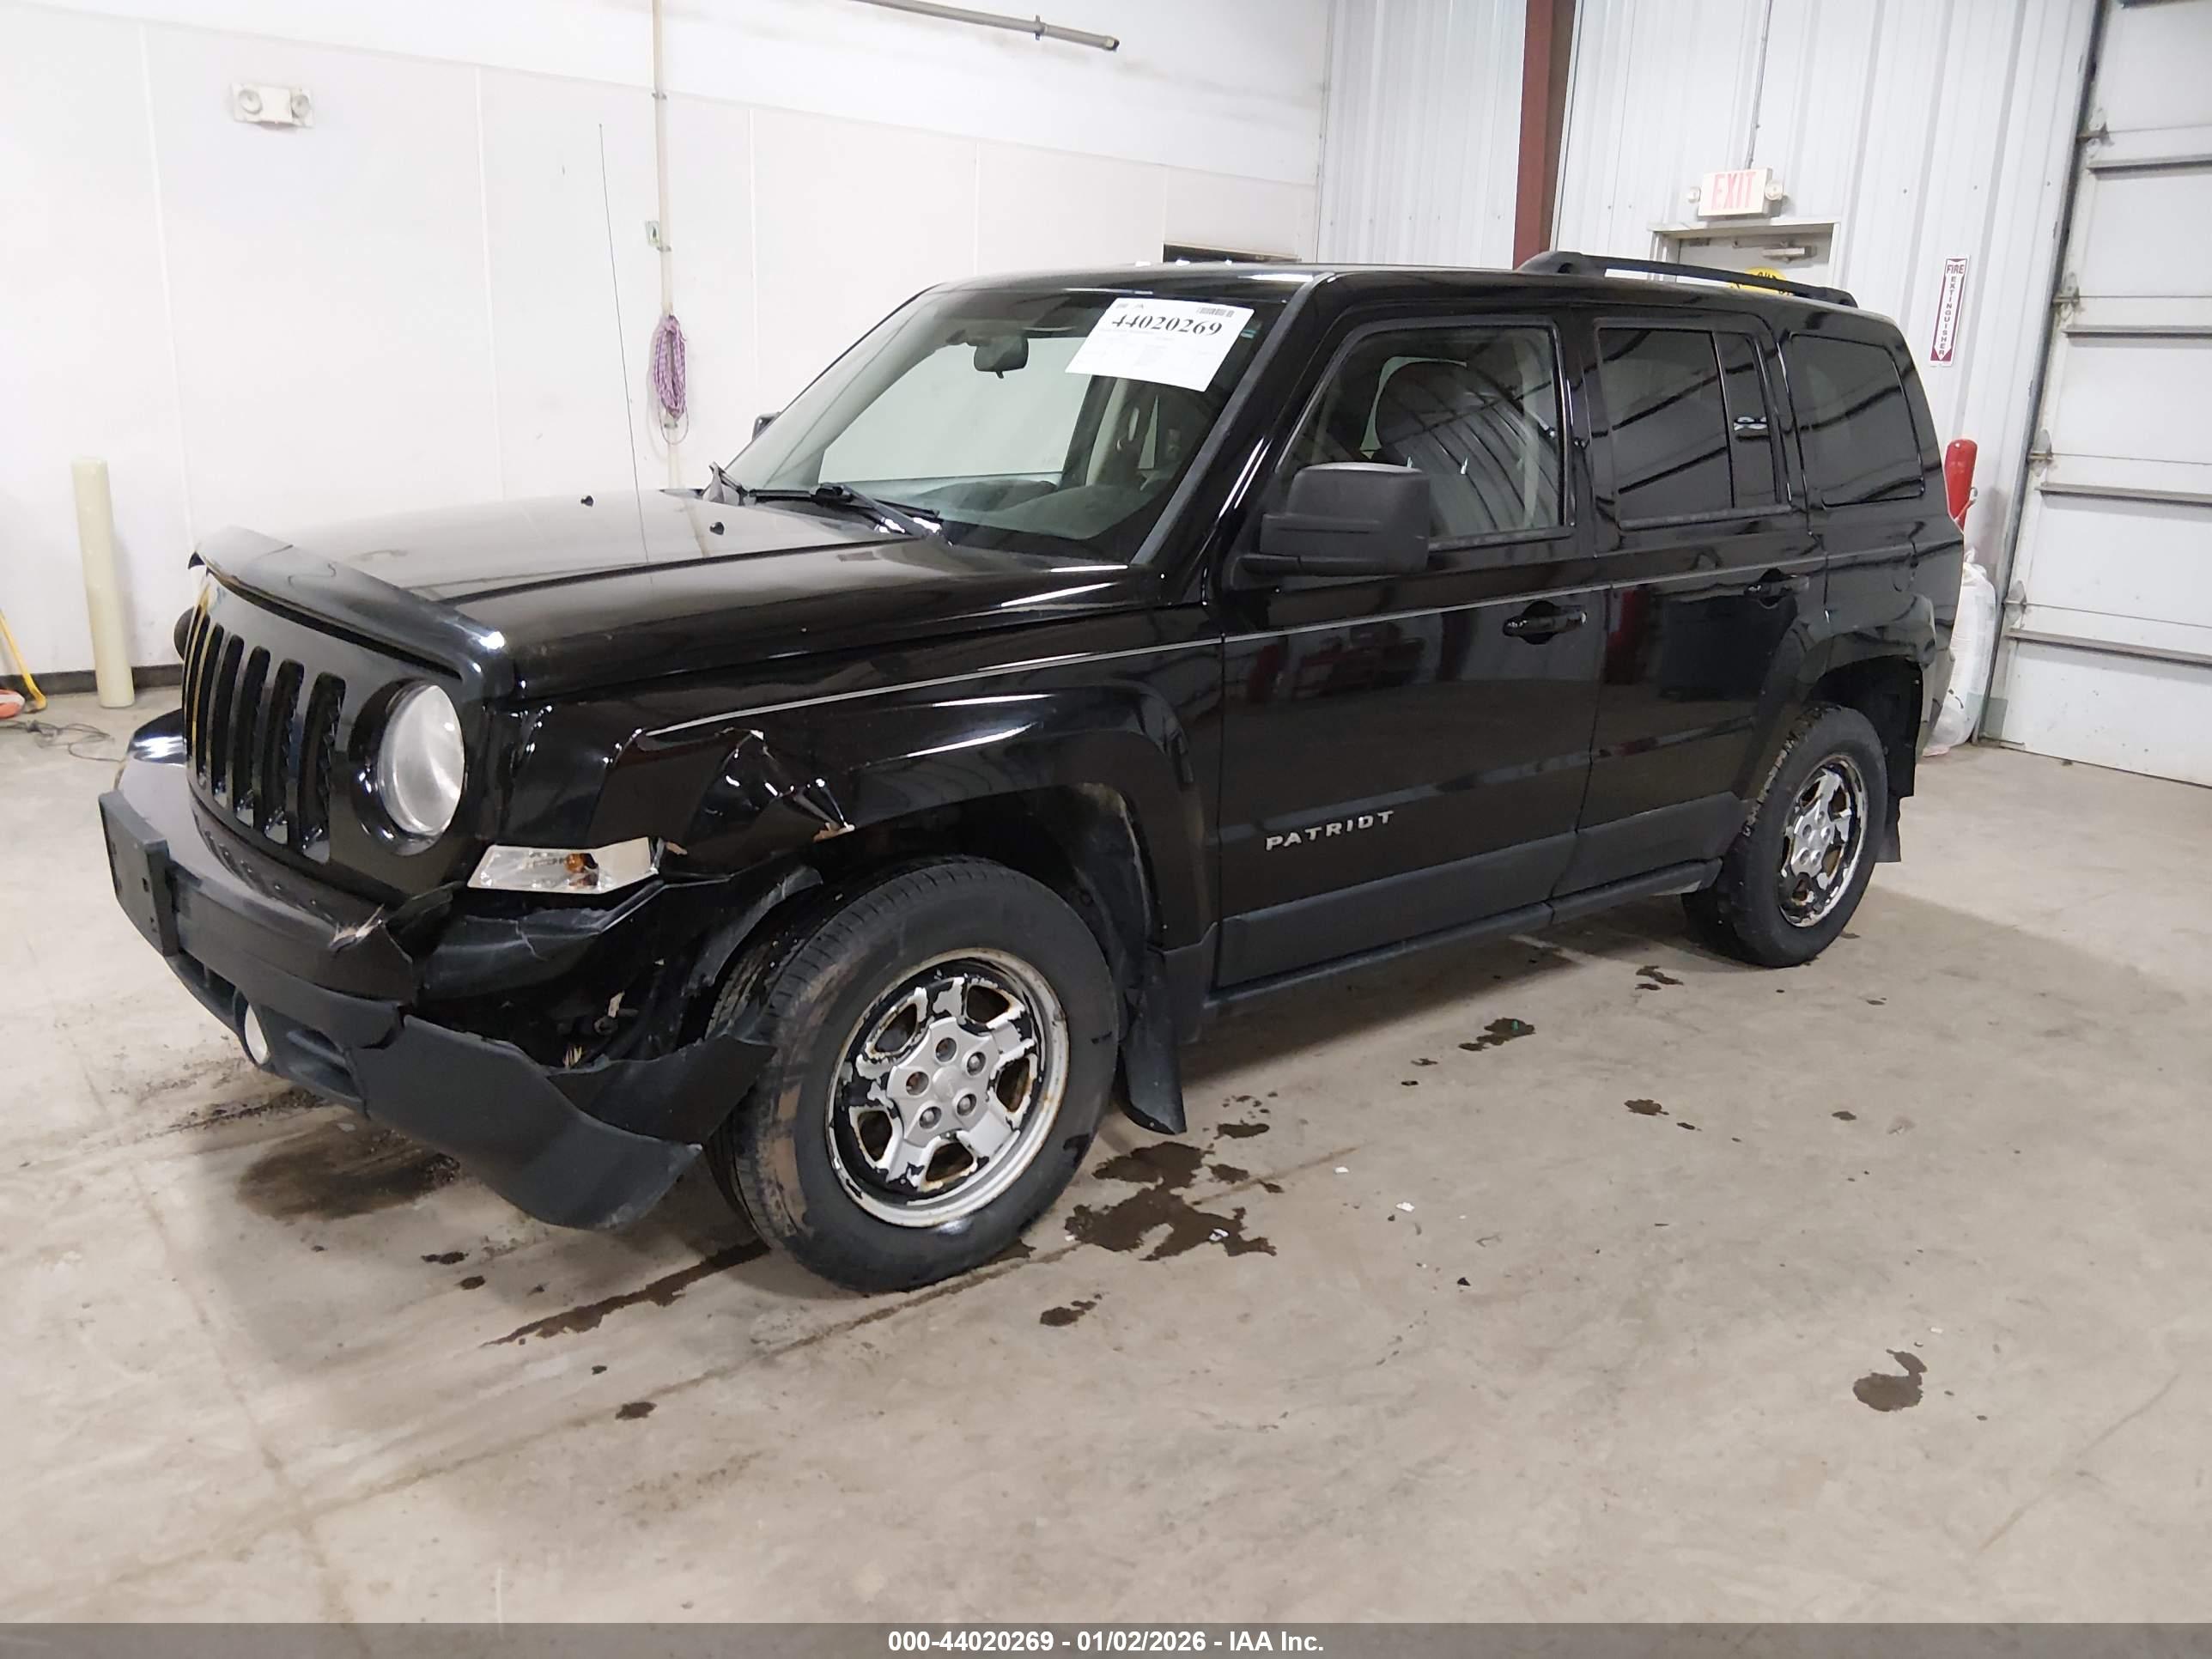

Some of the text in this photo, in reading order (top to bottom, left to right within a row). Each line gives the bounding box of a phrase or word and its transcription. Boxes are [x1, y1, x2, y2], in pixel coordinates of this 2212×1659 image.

[1711, 171, 1757, 210] EXIT
[1947, 264, 1965, 274] FIRE
[1112, 314, 1223, 335] 44020269
[1939, 276, 1956, 356] EXTINGUISHER
[1266, 810, 1394, 851] PATRIOT
